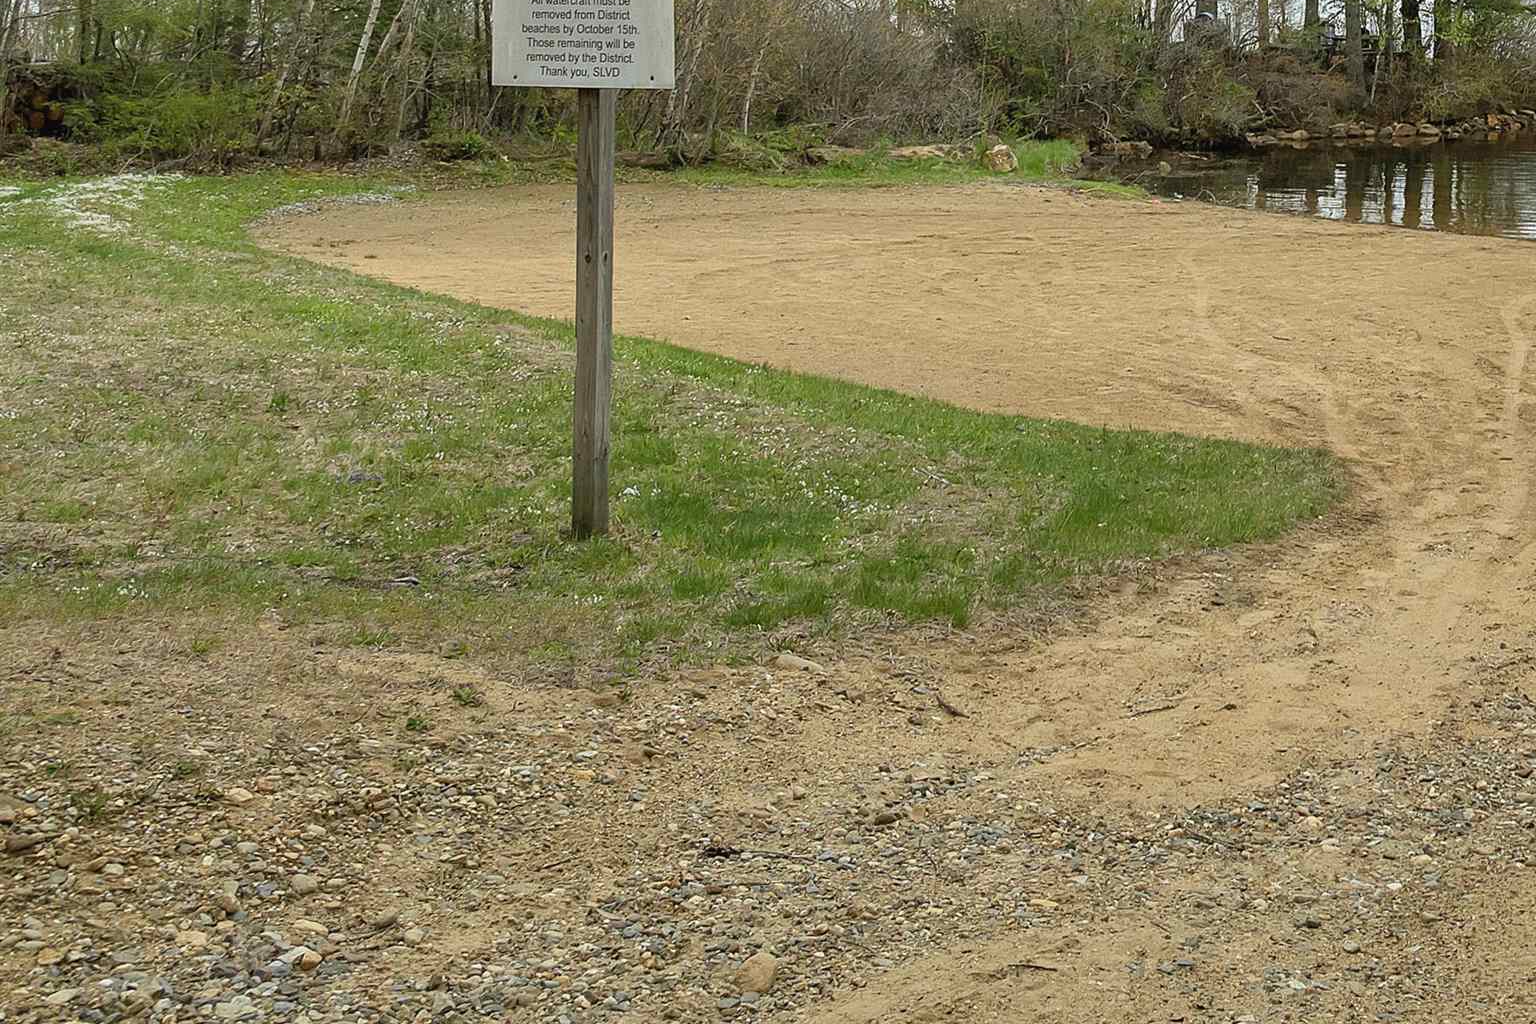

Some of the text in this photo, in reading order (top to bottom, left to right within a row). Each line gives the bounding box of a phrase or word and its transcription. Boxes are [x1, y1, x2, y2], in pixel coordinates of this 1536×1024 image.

[531, 10, 630, 20] removed from District
[522, 24, 640, 36] beaches by October 15th.
[527, 38, 635, 50] Those remaining will be
[526, 53, 635, 64] removed by the District.
[540, 66, 620, 79] Thank you, SLVD
